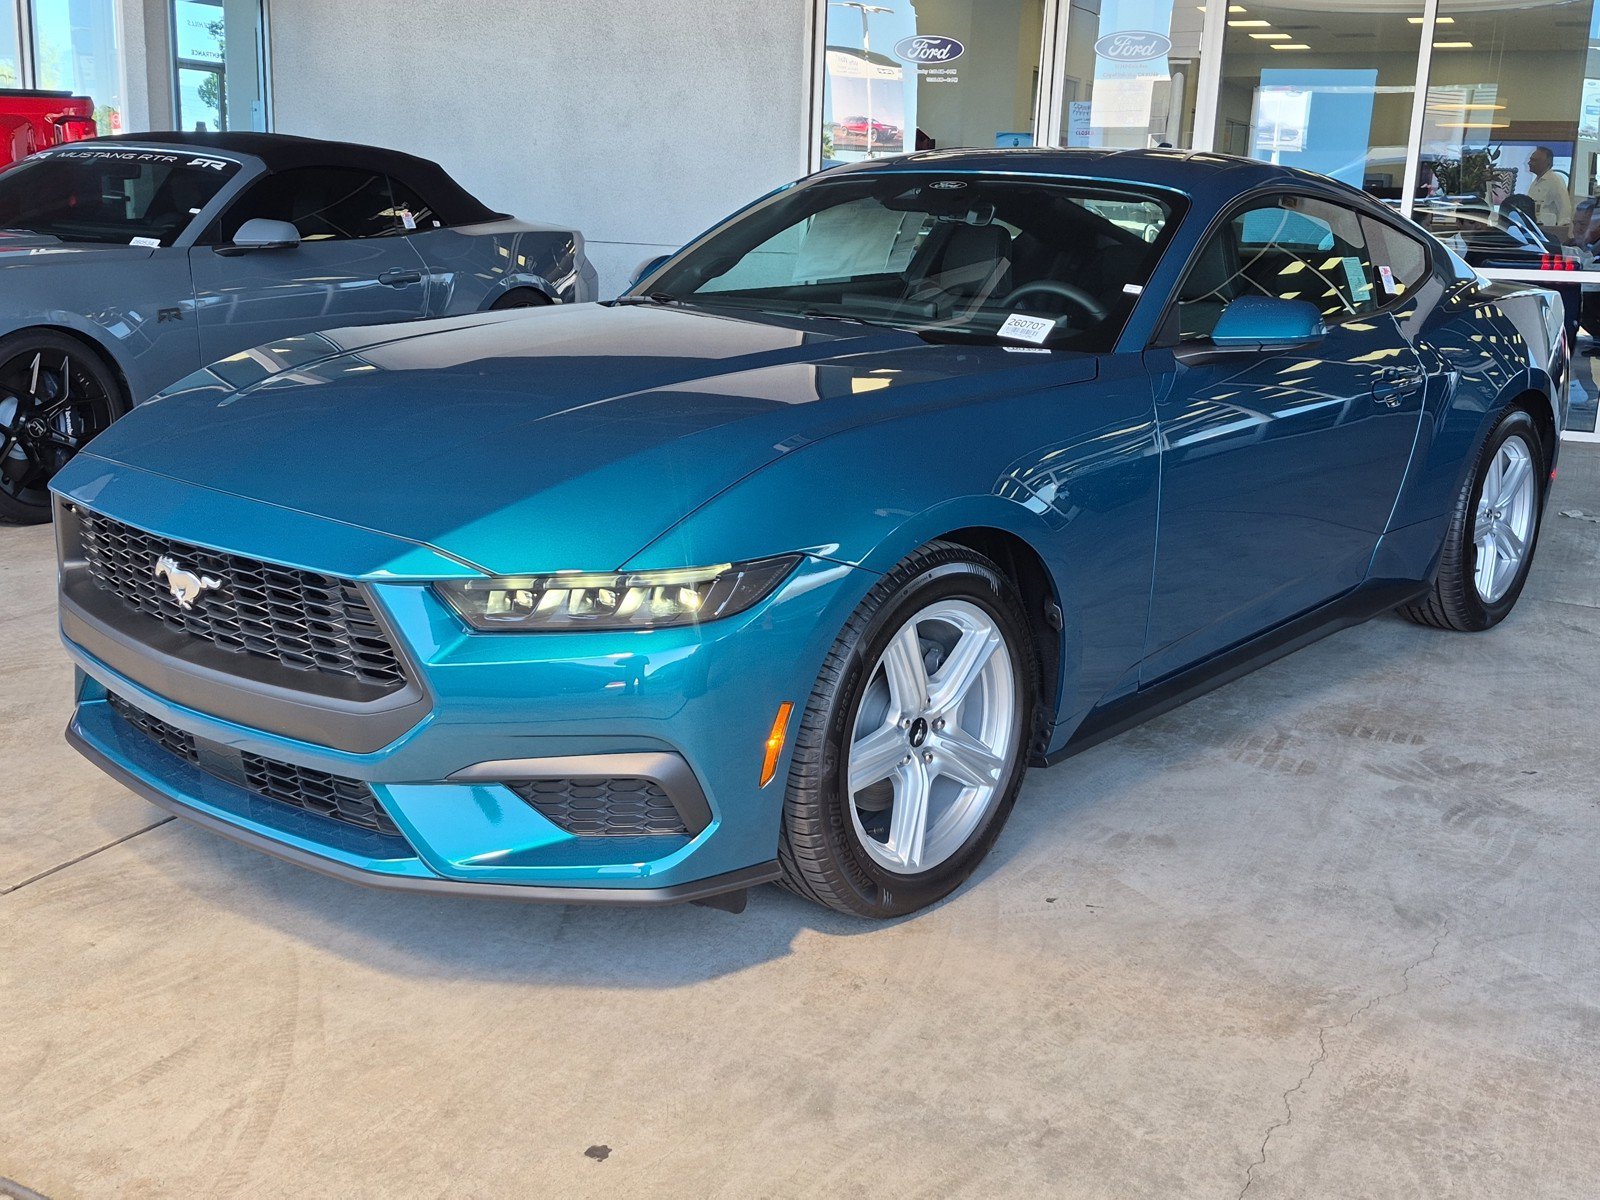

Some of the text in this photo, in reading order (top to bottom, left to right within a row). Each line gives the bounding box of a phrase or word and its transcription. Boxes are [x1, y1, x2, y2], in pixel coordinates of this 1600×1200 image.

[908, 38, 952, 59] Ford
[1108, 35, 1158, 56] Ford
[57, 152, 178, 163] MUSTANG RTR
[1007, 318, 1046, 331] 260707
